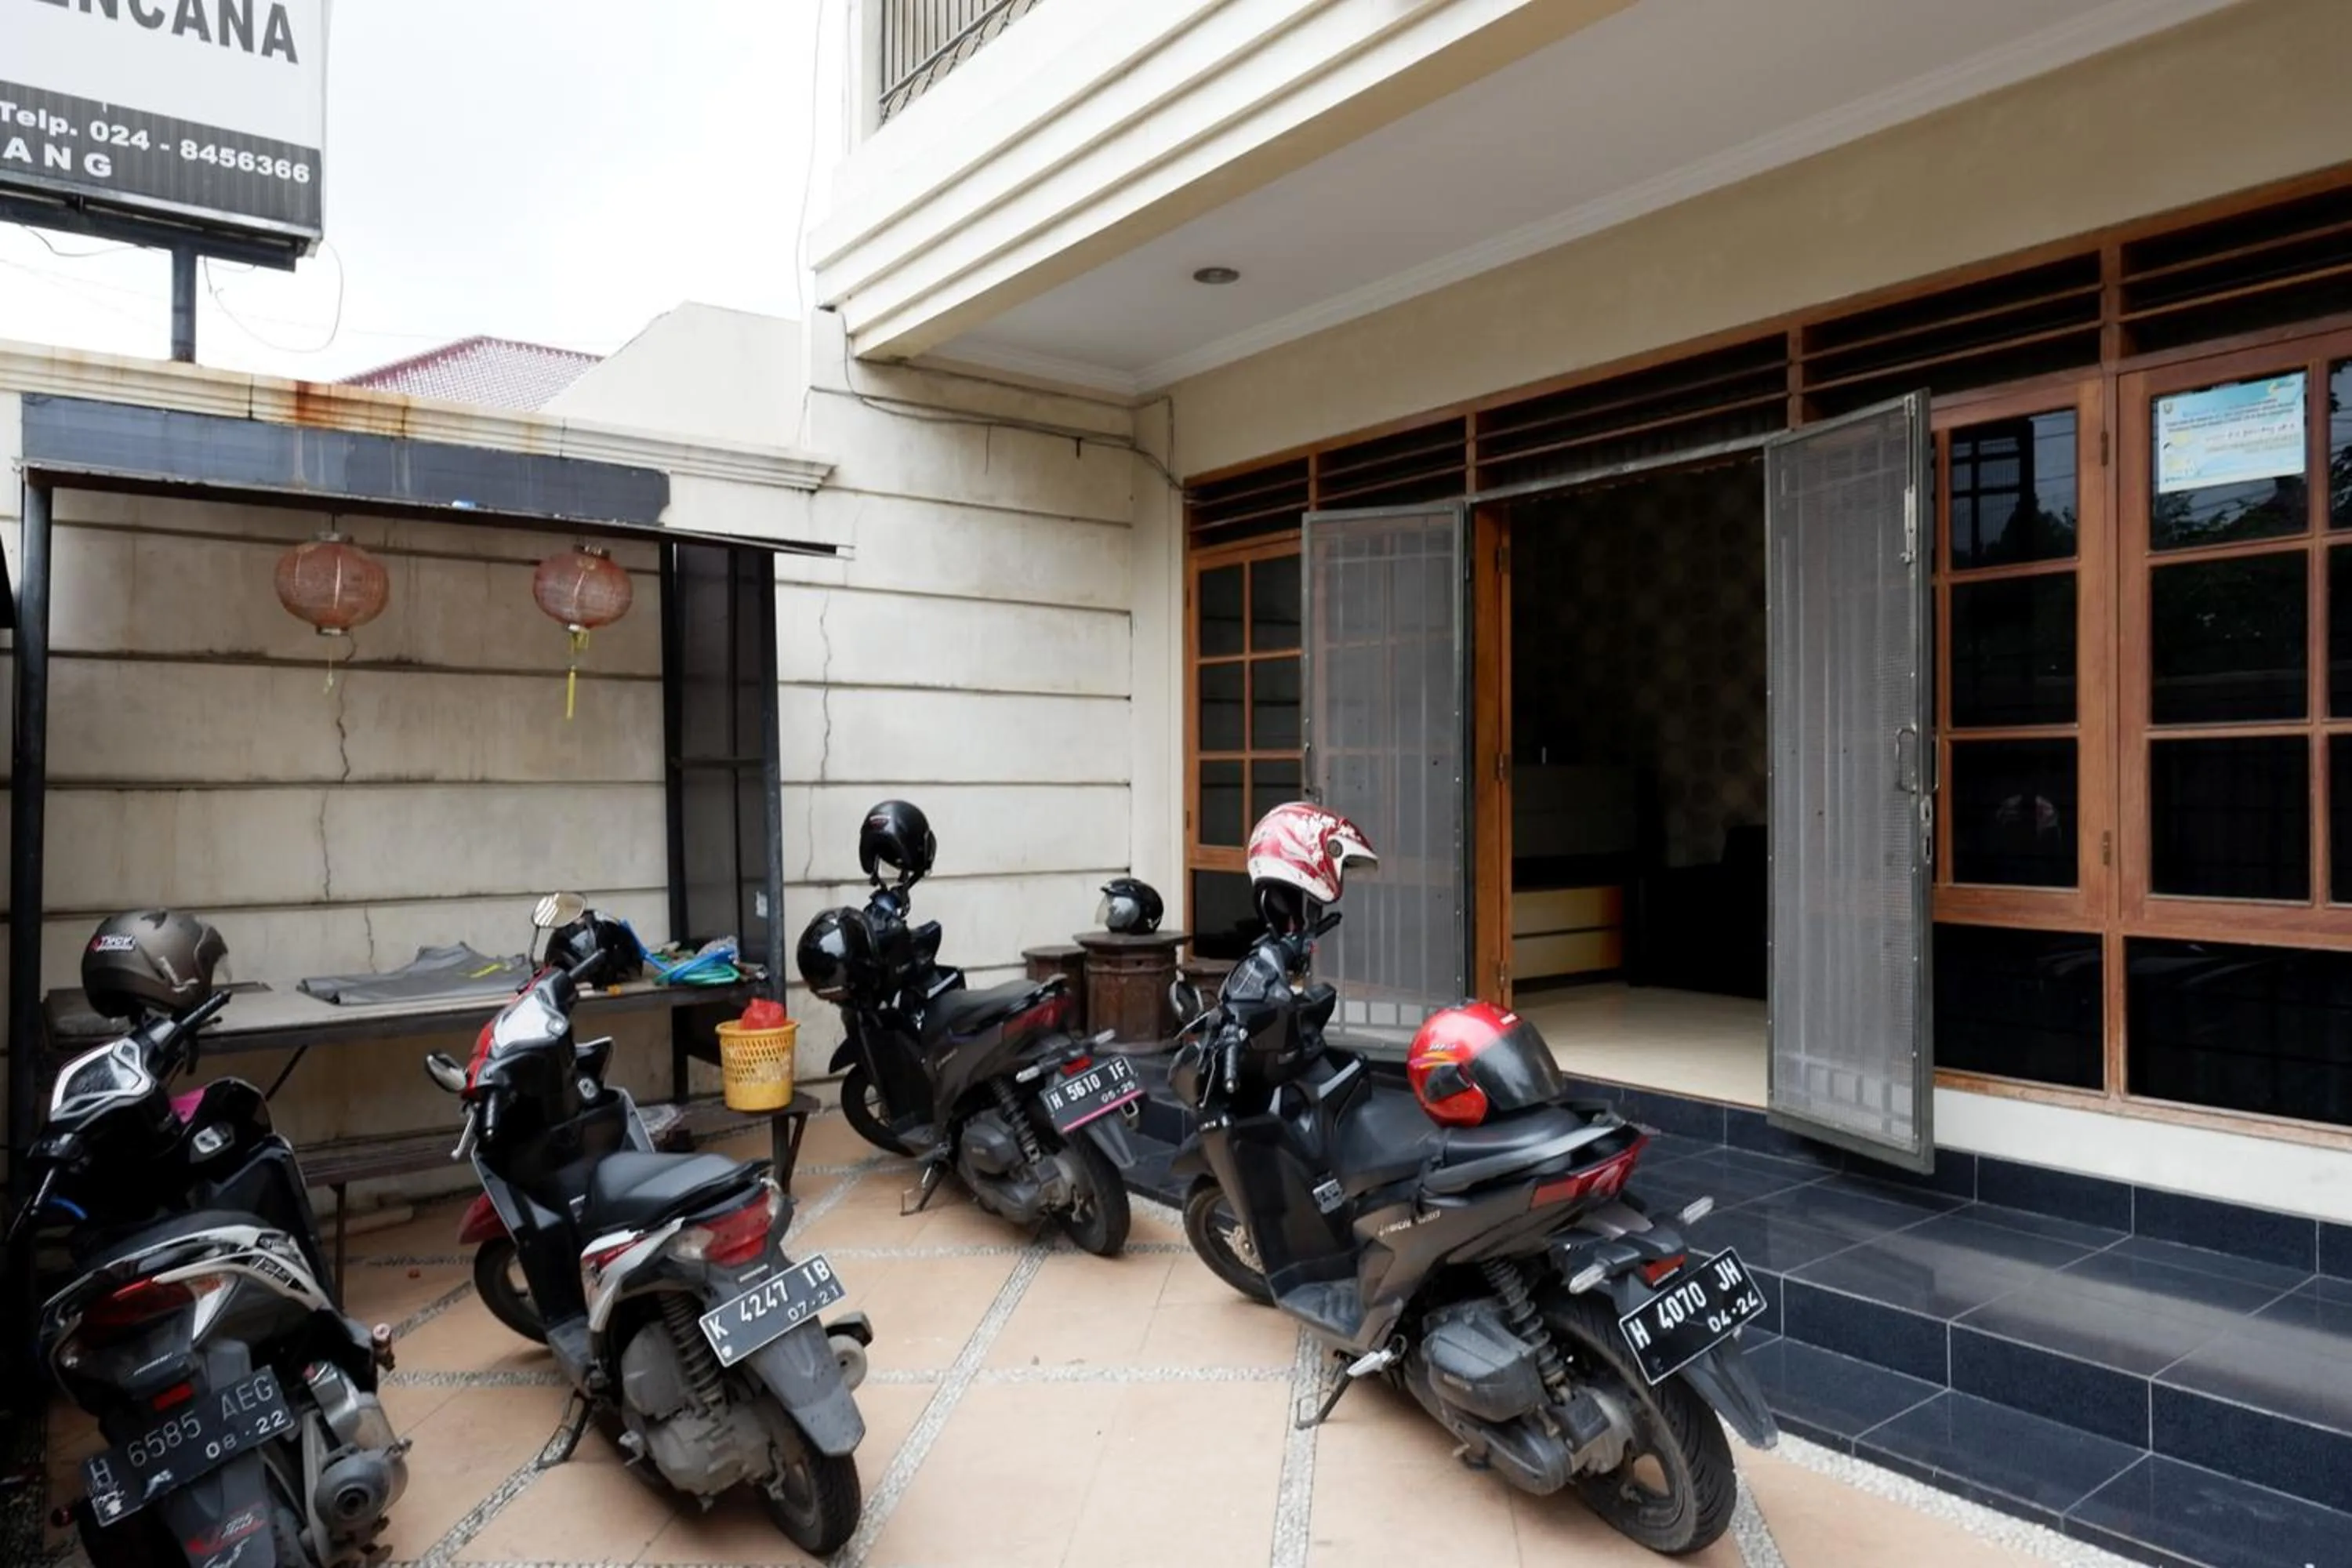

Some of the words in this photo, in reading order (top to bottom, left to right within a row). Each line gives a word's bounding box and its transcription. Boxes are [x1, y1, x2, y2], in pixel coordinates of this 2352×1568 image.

[33, 0, 299, 64] CANA
[0, 100, 78, 137] Telp.
[89, 120, 150, 151] 024
[180, 139, 310, 183] 8456366
[1051, 1091, 1065, 1109] H
[1065, 1073, 1101, 1102] 5610
[708, 1315, 729, 1340] K
[740, 1279, 789, 1323] 4247
[802, 1259, 831, 1288] IB
[1628, 1318, 1651, 1349] H
[1657, 1281, 1708, 1329] 4070
[1714, 1257, 1743, 1291] JH
[128, 1410, 201, 1468] 6585
[220, 1375, 274, 1421] AEG
